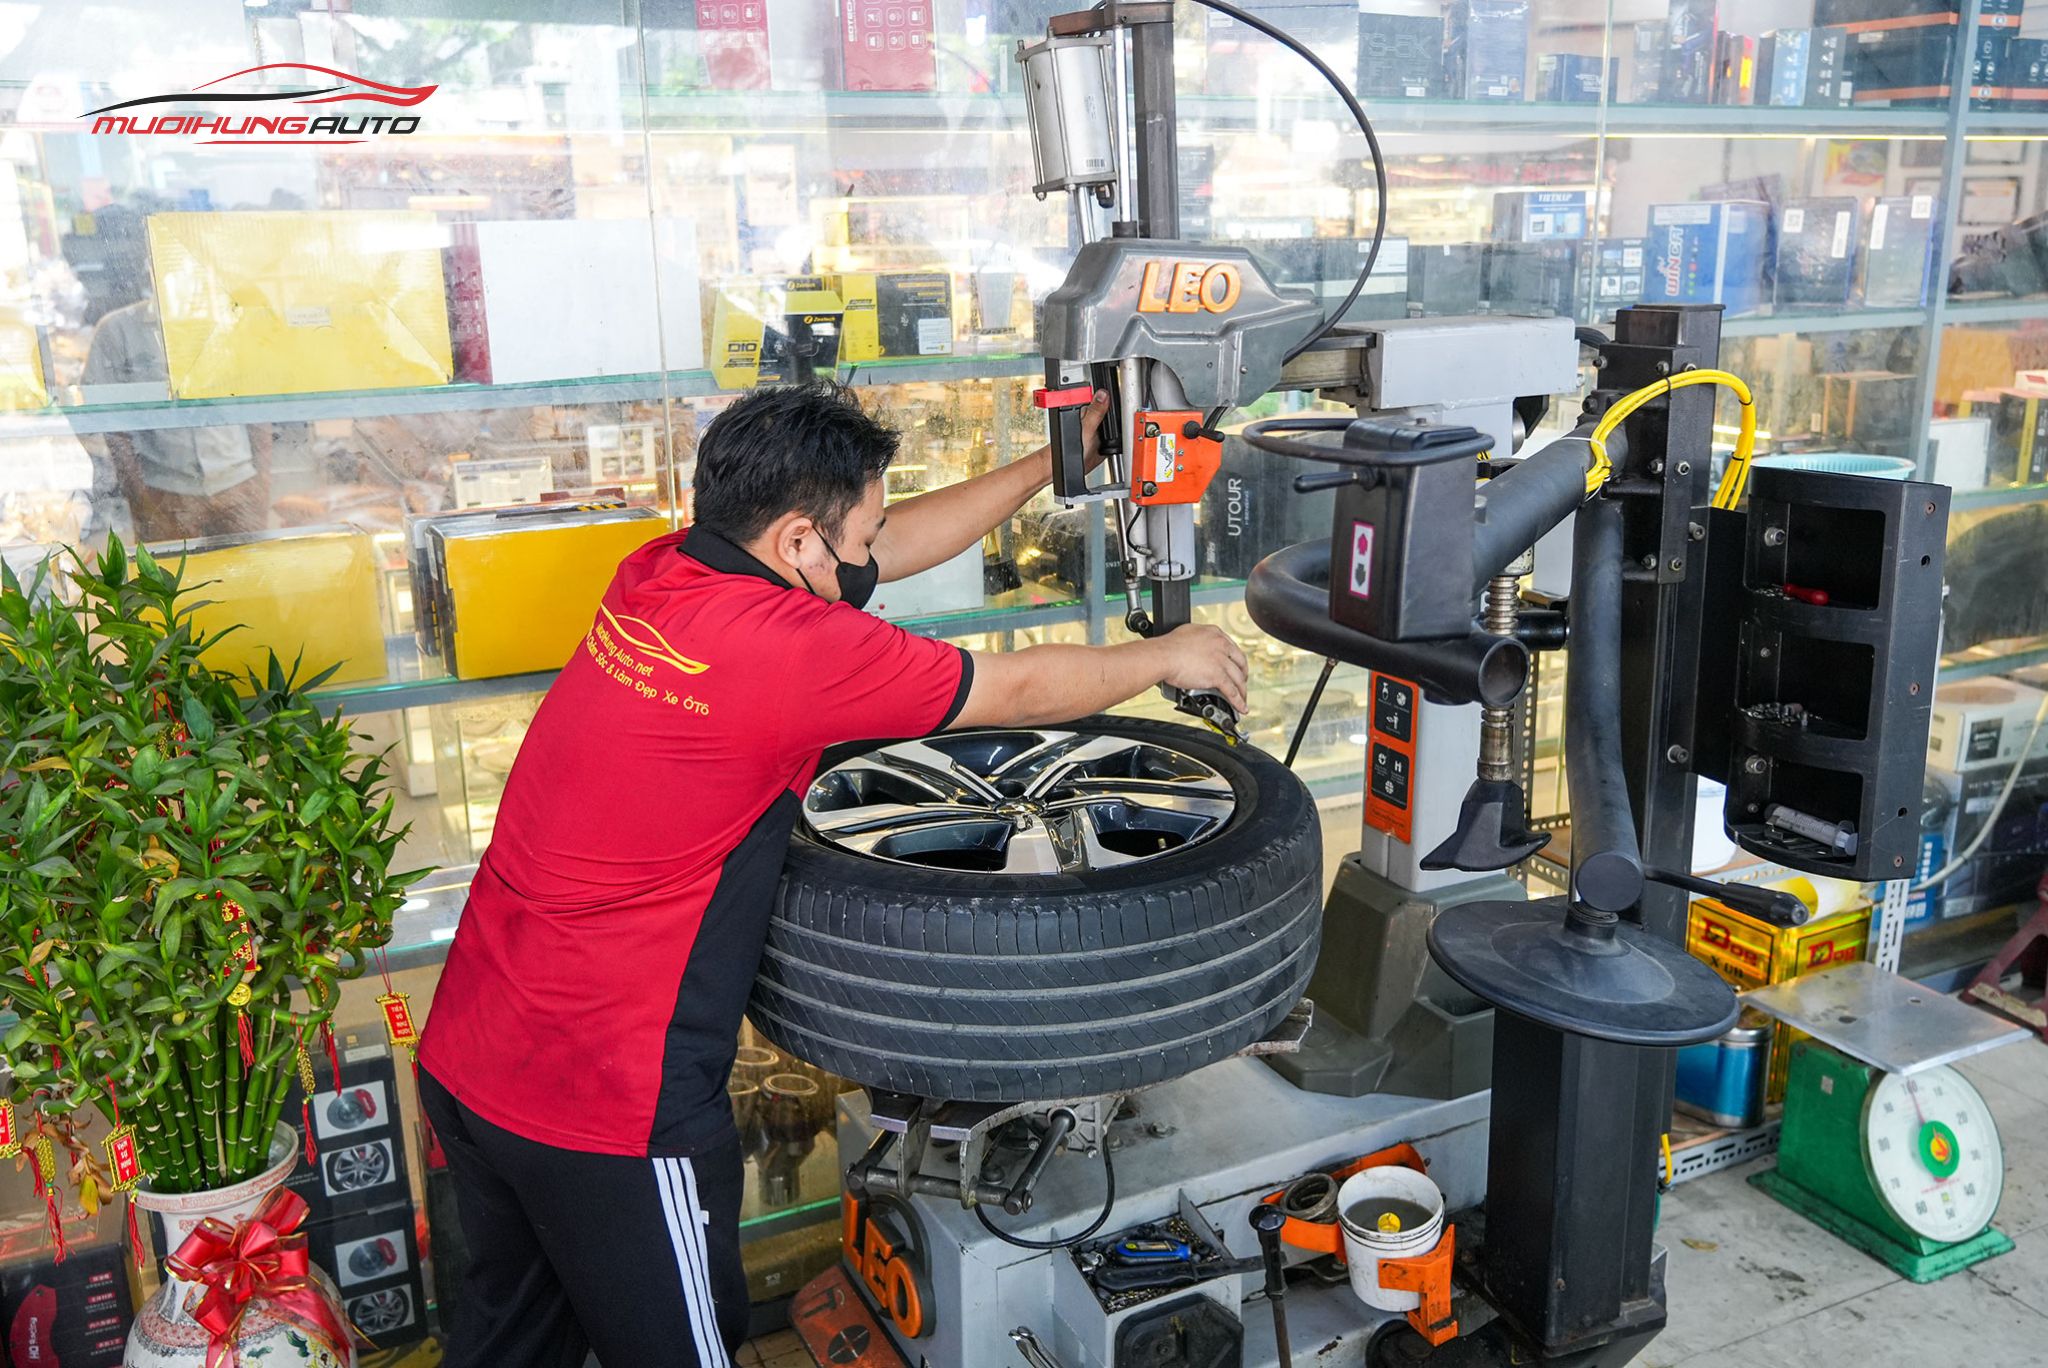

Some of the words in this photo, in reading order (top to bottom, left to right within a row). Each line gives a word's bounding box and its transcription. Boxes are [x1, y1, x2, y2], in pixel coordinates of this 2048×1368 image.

[1138, 261, 1242, 314] LEO
[1227, 478, 1242, 536] UTOUR
[605, 663, 615, 674] &
[613, 668, 633, 687] Làm
[635, 680, 658, 699] Đẹp
[662, 689, 679, 706] Xe
[1956, 1111, 1968, 1125] 20
[843, 1190, 923, 1338] LEO
